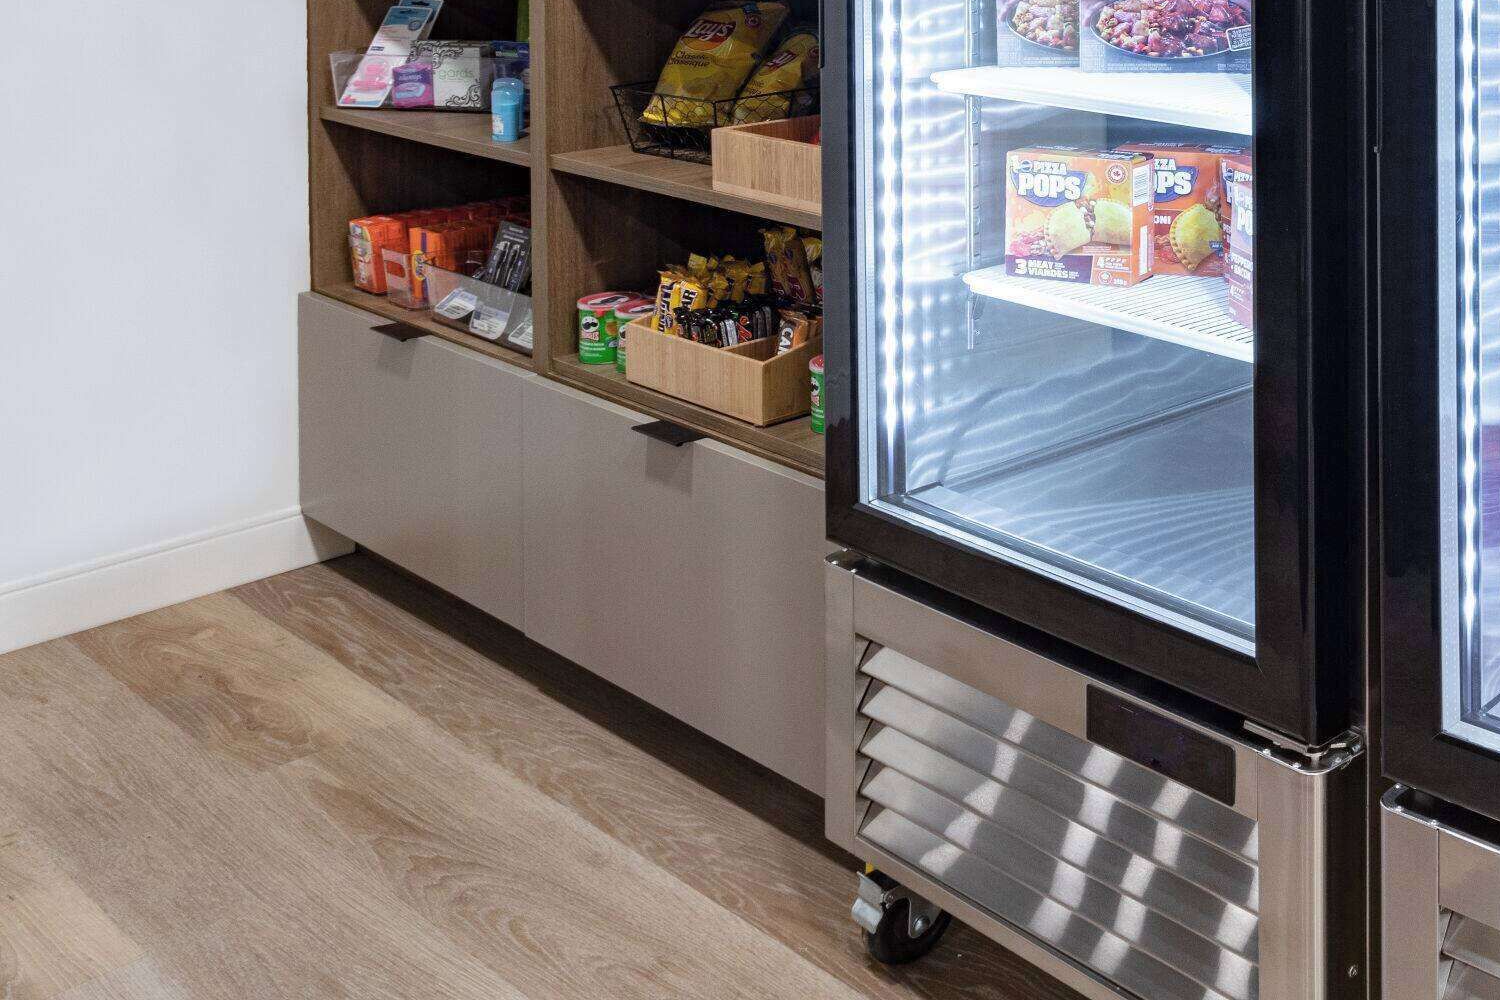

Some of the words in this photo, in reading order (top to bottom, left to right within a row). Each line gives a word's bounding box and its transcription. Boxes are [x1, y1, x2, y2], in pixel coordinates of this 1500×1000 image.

[1033, 161, 1067, 175] PIZZA
[1017, 172, 1083, 201] POPS
[1014, 258, 1027, 274] 3
